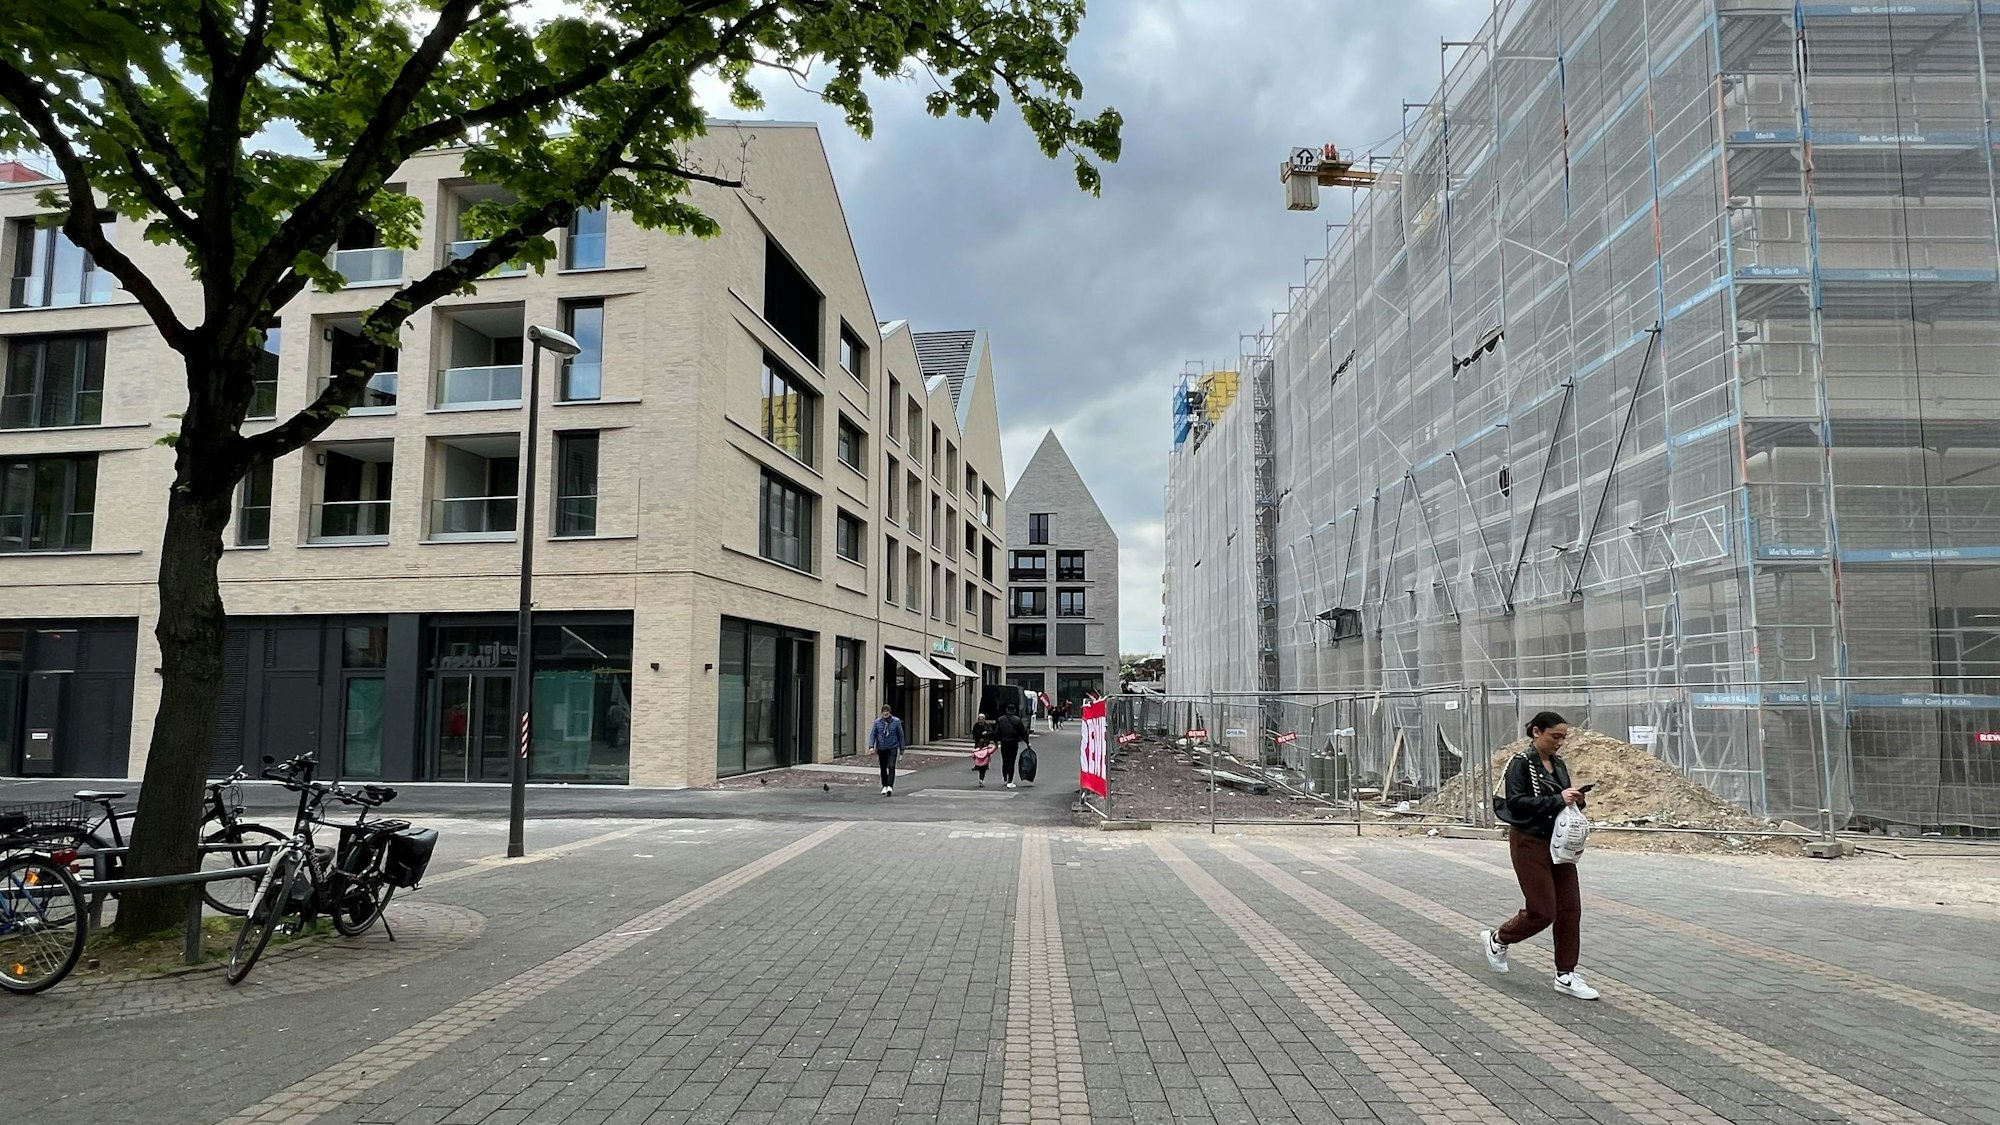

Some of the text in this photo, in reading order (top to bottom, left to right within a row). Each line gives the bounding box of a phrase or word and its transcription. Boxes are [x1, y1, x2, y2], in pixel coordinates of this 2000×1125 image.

[1774, 267, 1799, 275] GmbH
[1790, 548, 1815, 556] GmbH
[1913, 550, 1939, 558] GmbH
[1924, 698, 1951, 706] GmbH
[1119, 733, 1136, 743] REWE
[1277, 733, 1295, 743] REWE
[1080, 716, 1107, 780] REWE
